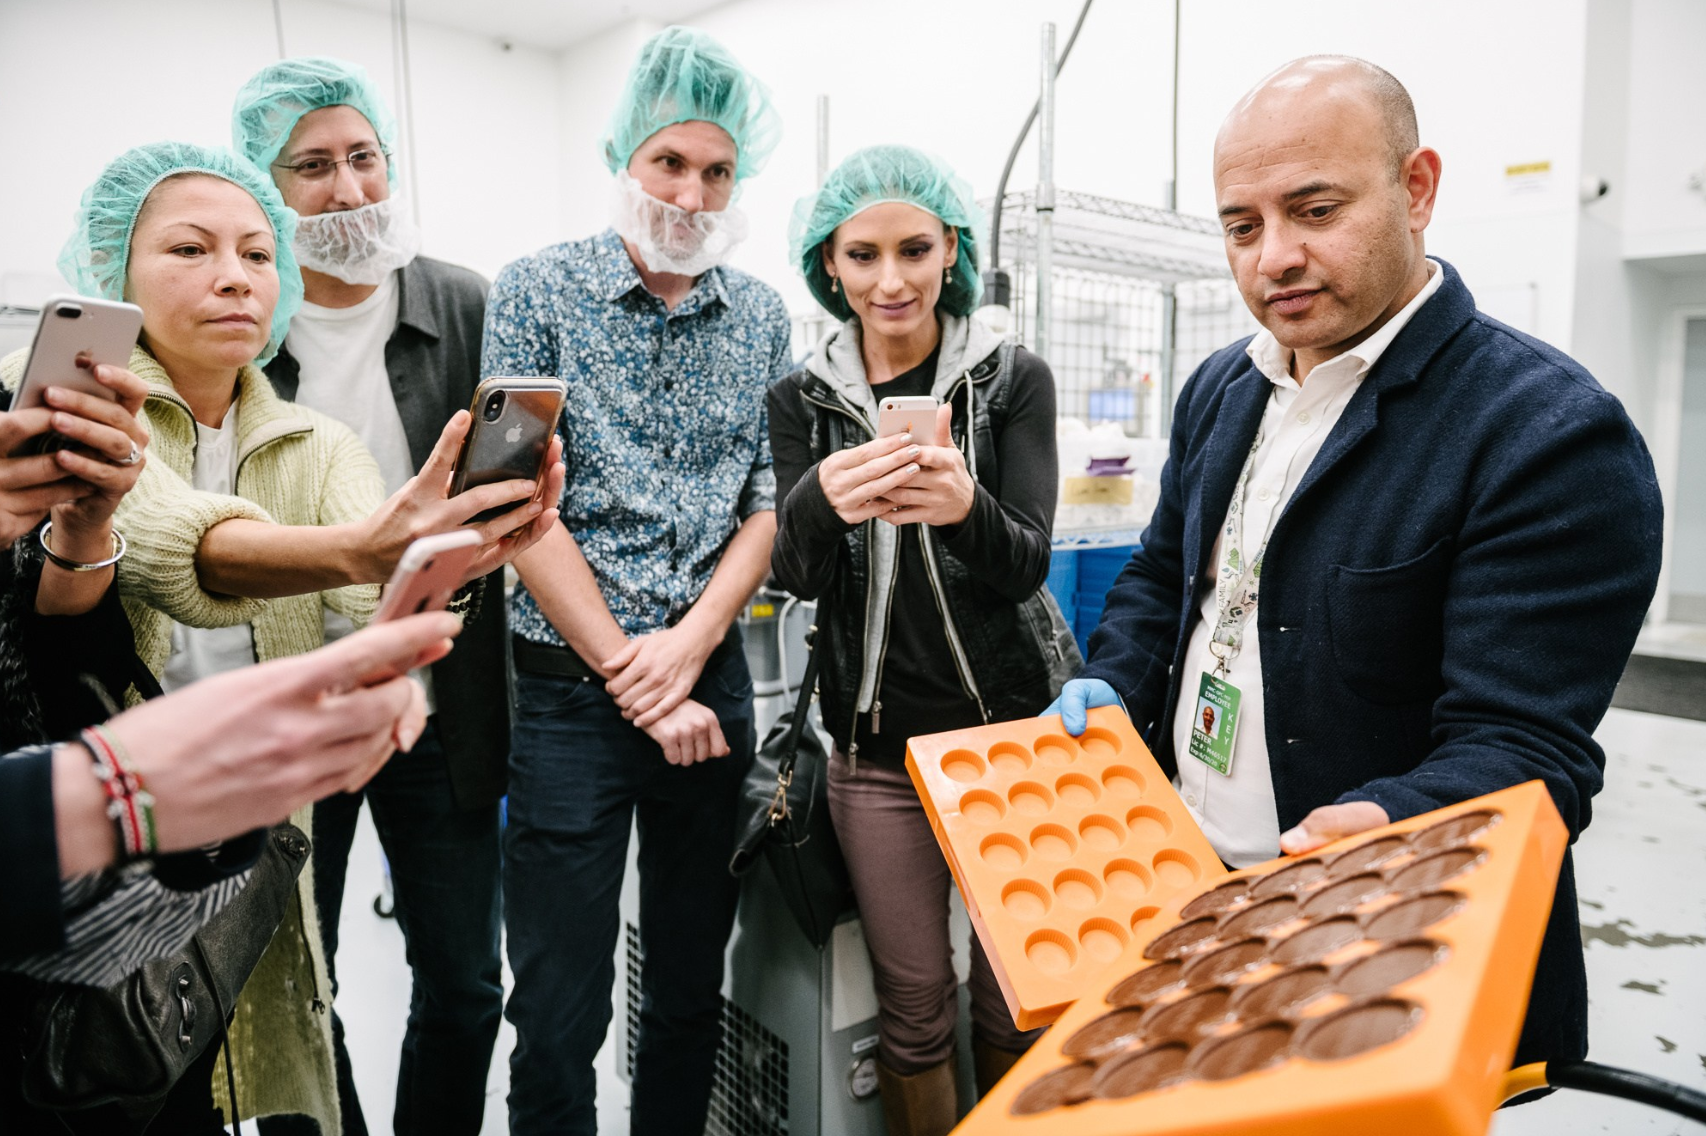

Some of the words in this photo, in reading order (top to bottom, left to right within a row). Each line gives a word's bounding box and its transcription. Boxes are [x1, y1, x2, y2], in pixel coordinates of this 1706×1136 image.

[1218, 578, 1227, 608] FAMILY
[1204, 690, 1231, 709] EMPLOYEE
[1193, 729, 1212, 745] PETER
